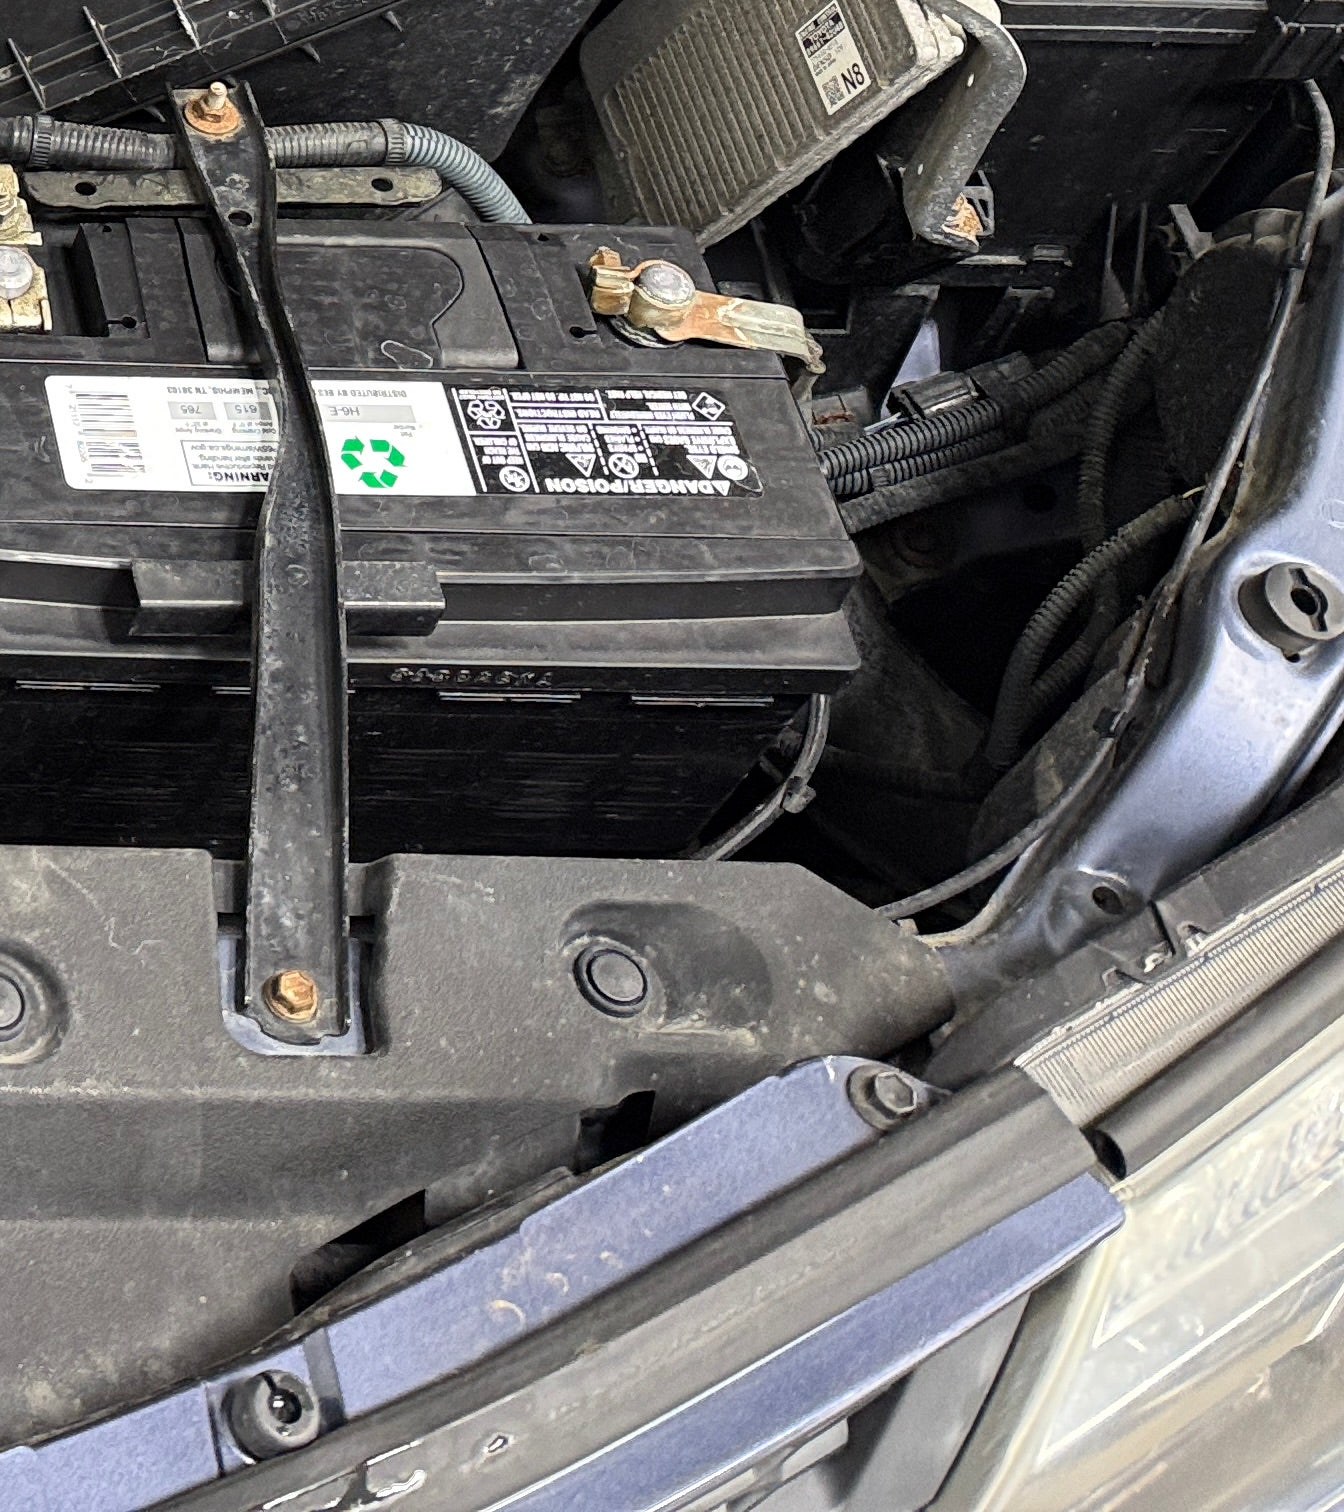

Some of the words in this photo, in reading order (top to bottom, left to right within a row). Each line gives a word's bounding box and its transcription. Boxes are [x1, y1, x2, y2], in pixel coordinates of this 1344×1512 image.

[841, 63, 864, 94] N8
[207, 472, 270, 482] ARNING:
[544, 478, 715, 495] DANGER/POISON
